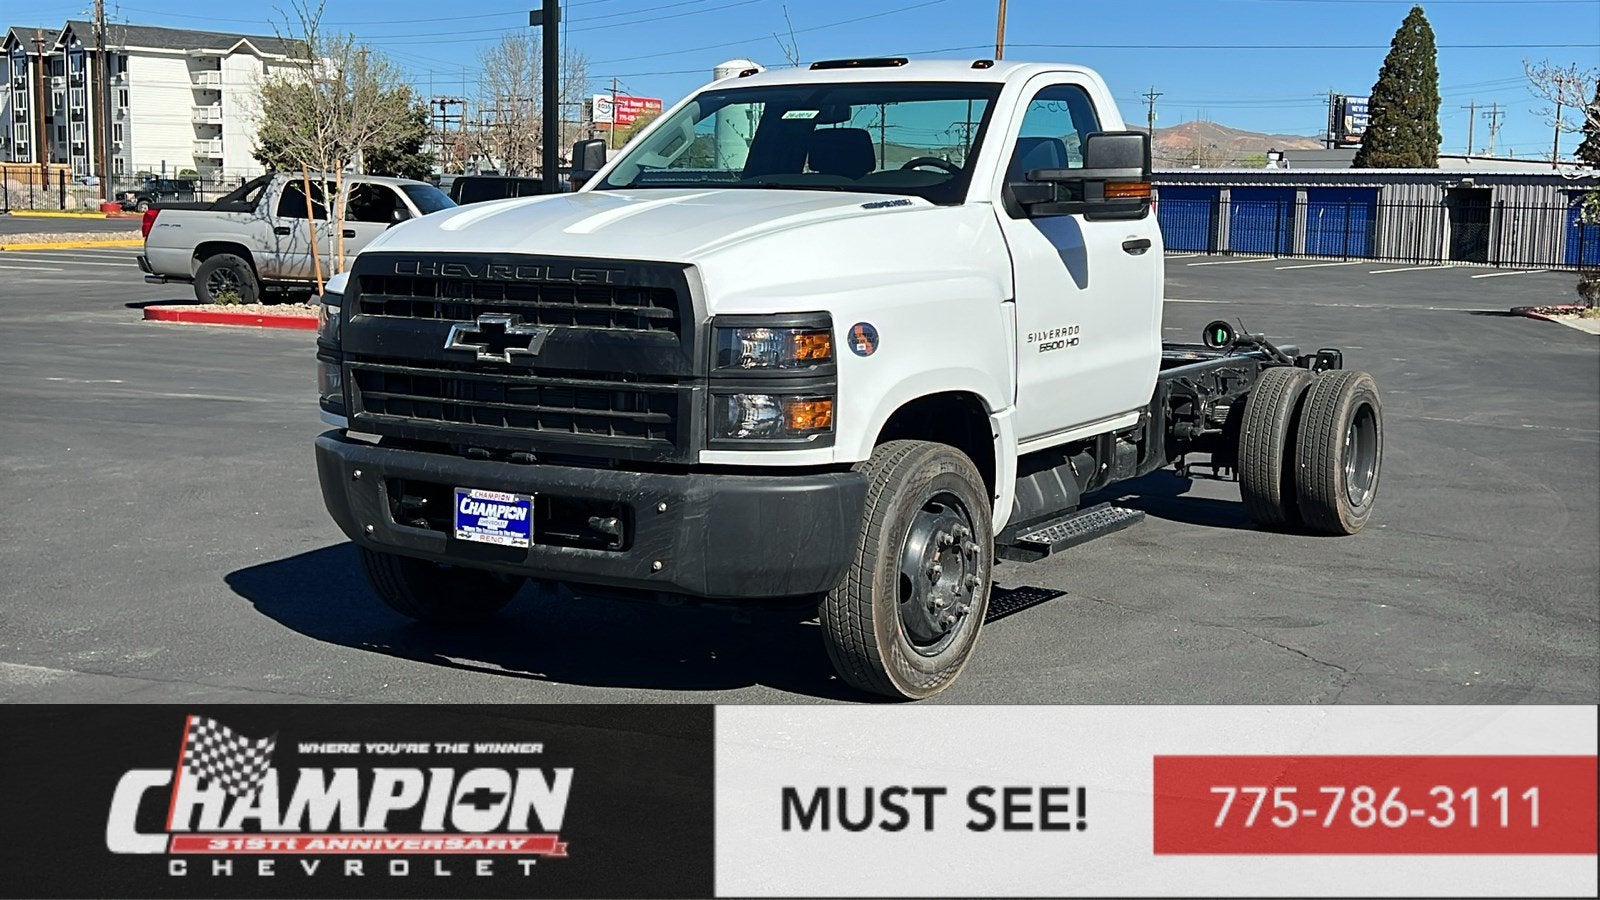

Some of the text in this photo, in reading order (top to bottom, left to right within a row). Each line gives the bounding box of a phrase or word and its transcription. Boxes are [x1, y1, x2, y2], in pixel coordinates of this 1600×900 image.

[395, 260, 625, 284] CHEVROLET
[1026, 325, 1080, 343] SILVERADO
[1066, 337, 1080, 348] HD
[474, 491, 511, 502] CHAMPION
[460, 497, 527, 521] CHAMPION
[479, 534, 504, 544] RENO
